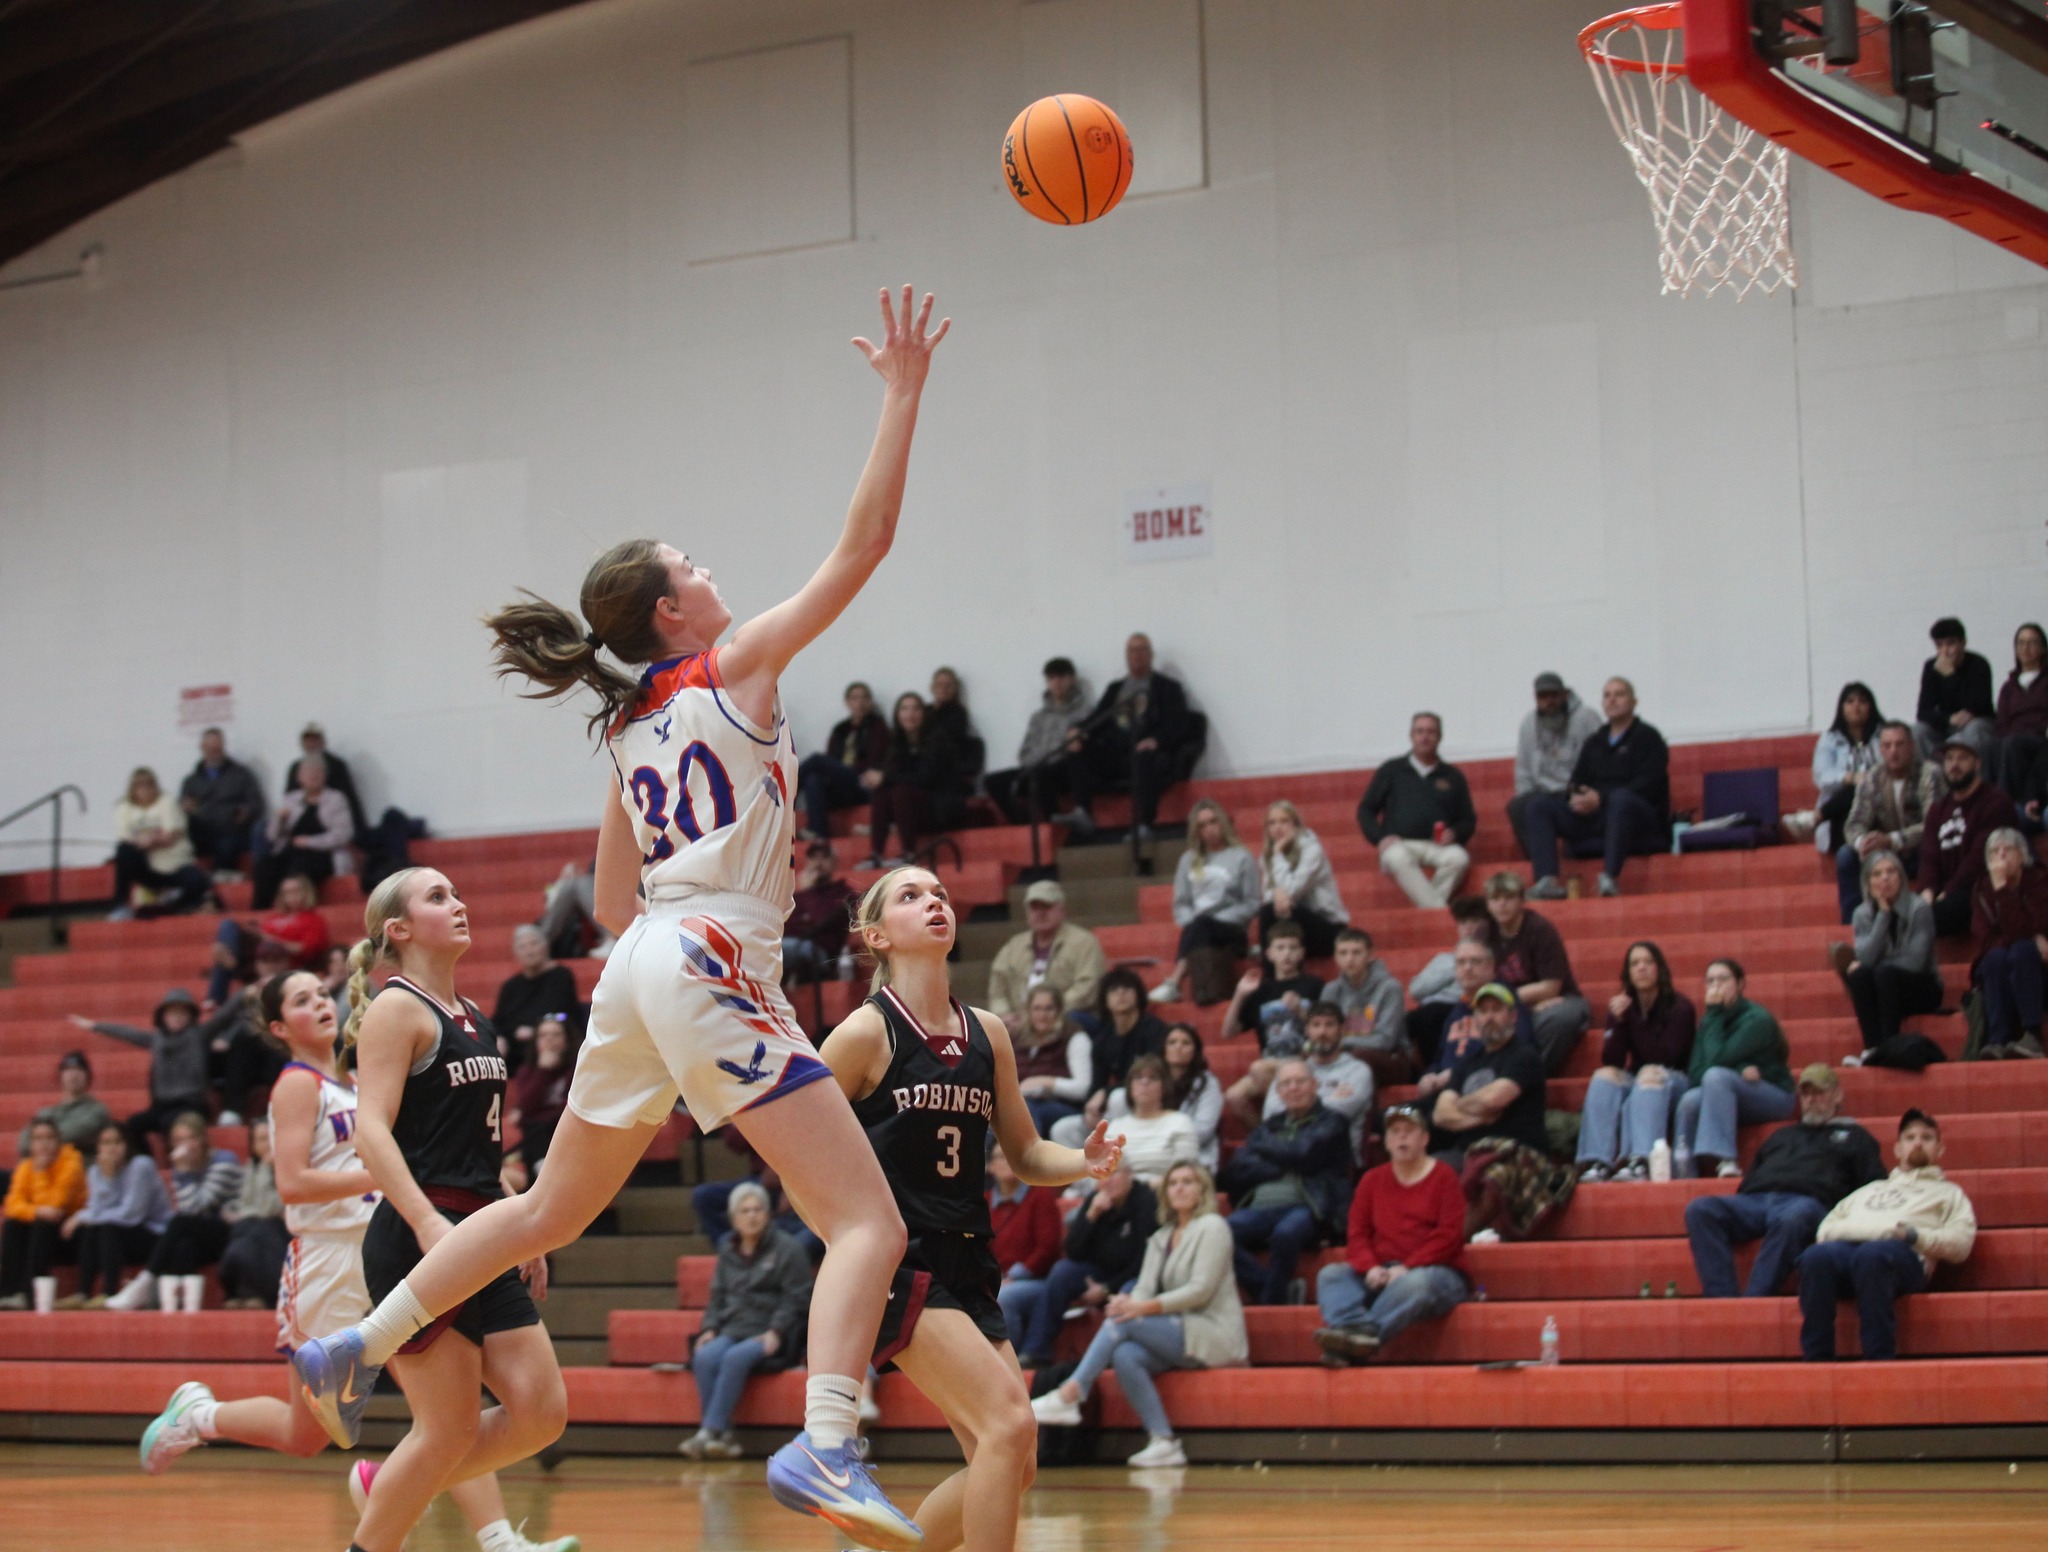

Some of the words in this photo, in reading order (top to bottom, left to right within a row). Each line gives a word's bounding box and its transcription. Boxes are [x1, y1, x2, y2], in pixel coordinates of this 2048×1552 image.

[1004, 134, 1030, 198] NCAA
[1133, 504, 1204, 543] HOME
[628, 739, 737, 866] 30
[446, 1055, 508, 1087] ROBINS
[486, 1093, 501, 1142] 4
[936, 1125, 962, 1177] 3
